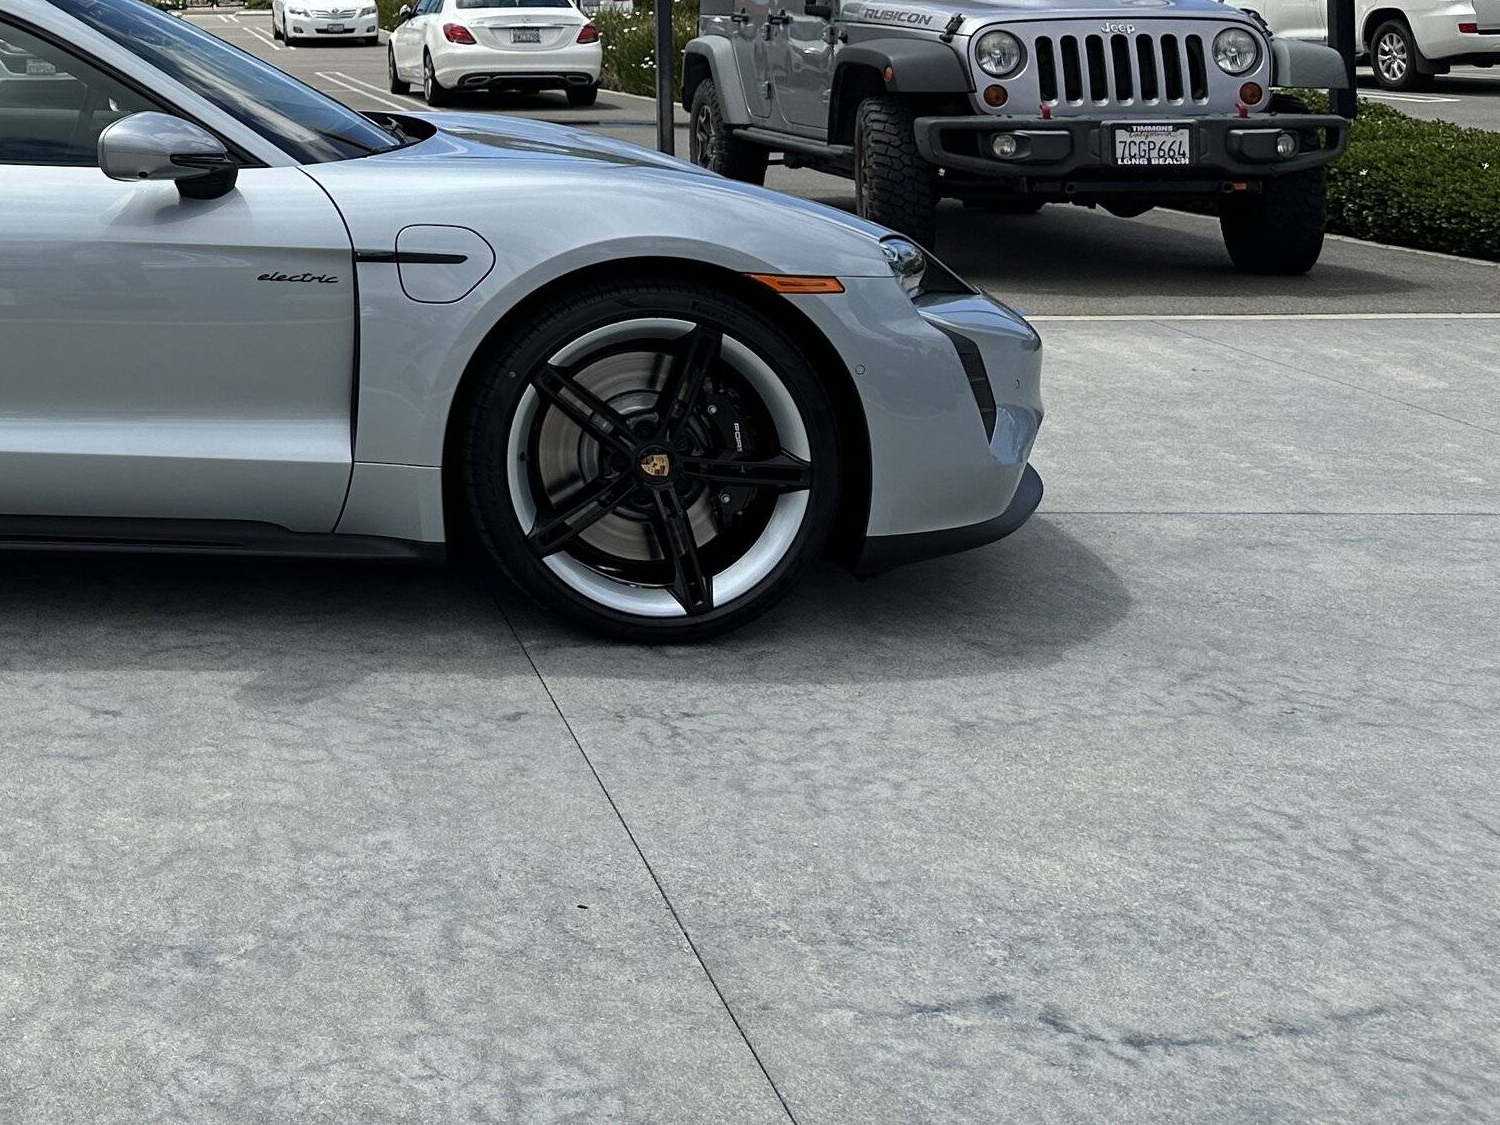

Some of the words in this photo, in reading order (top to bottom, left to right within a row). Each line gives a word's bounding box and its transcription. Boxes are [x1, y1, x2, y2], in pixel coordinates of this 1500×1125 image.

[864, 8, 932, 25] RUBICON
[1101, 22, 1135, 35] Jeep
[1118, 140, 1187, 159] 7CGP664
[1117, 157, 1148, 165] LONG
[1151, 157, 1190, 165] BEACH
[257, 271, 340, 284] electric
